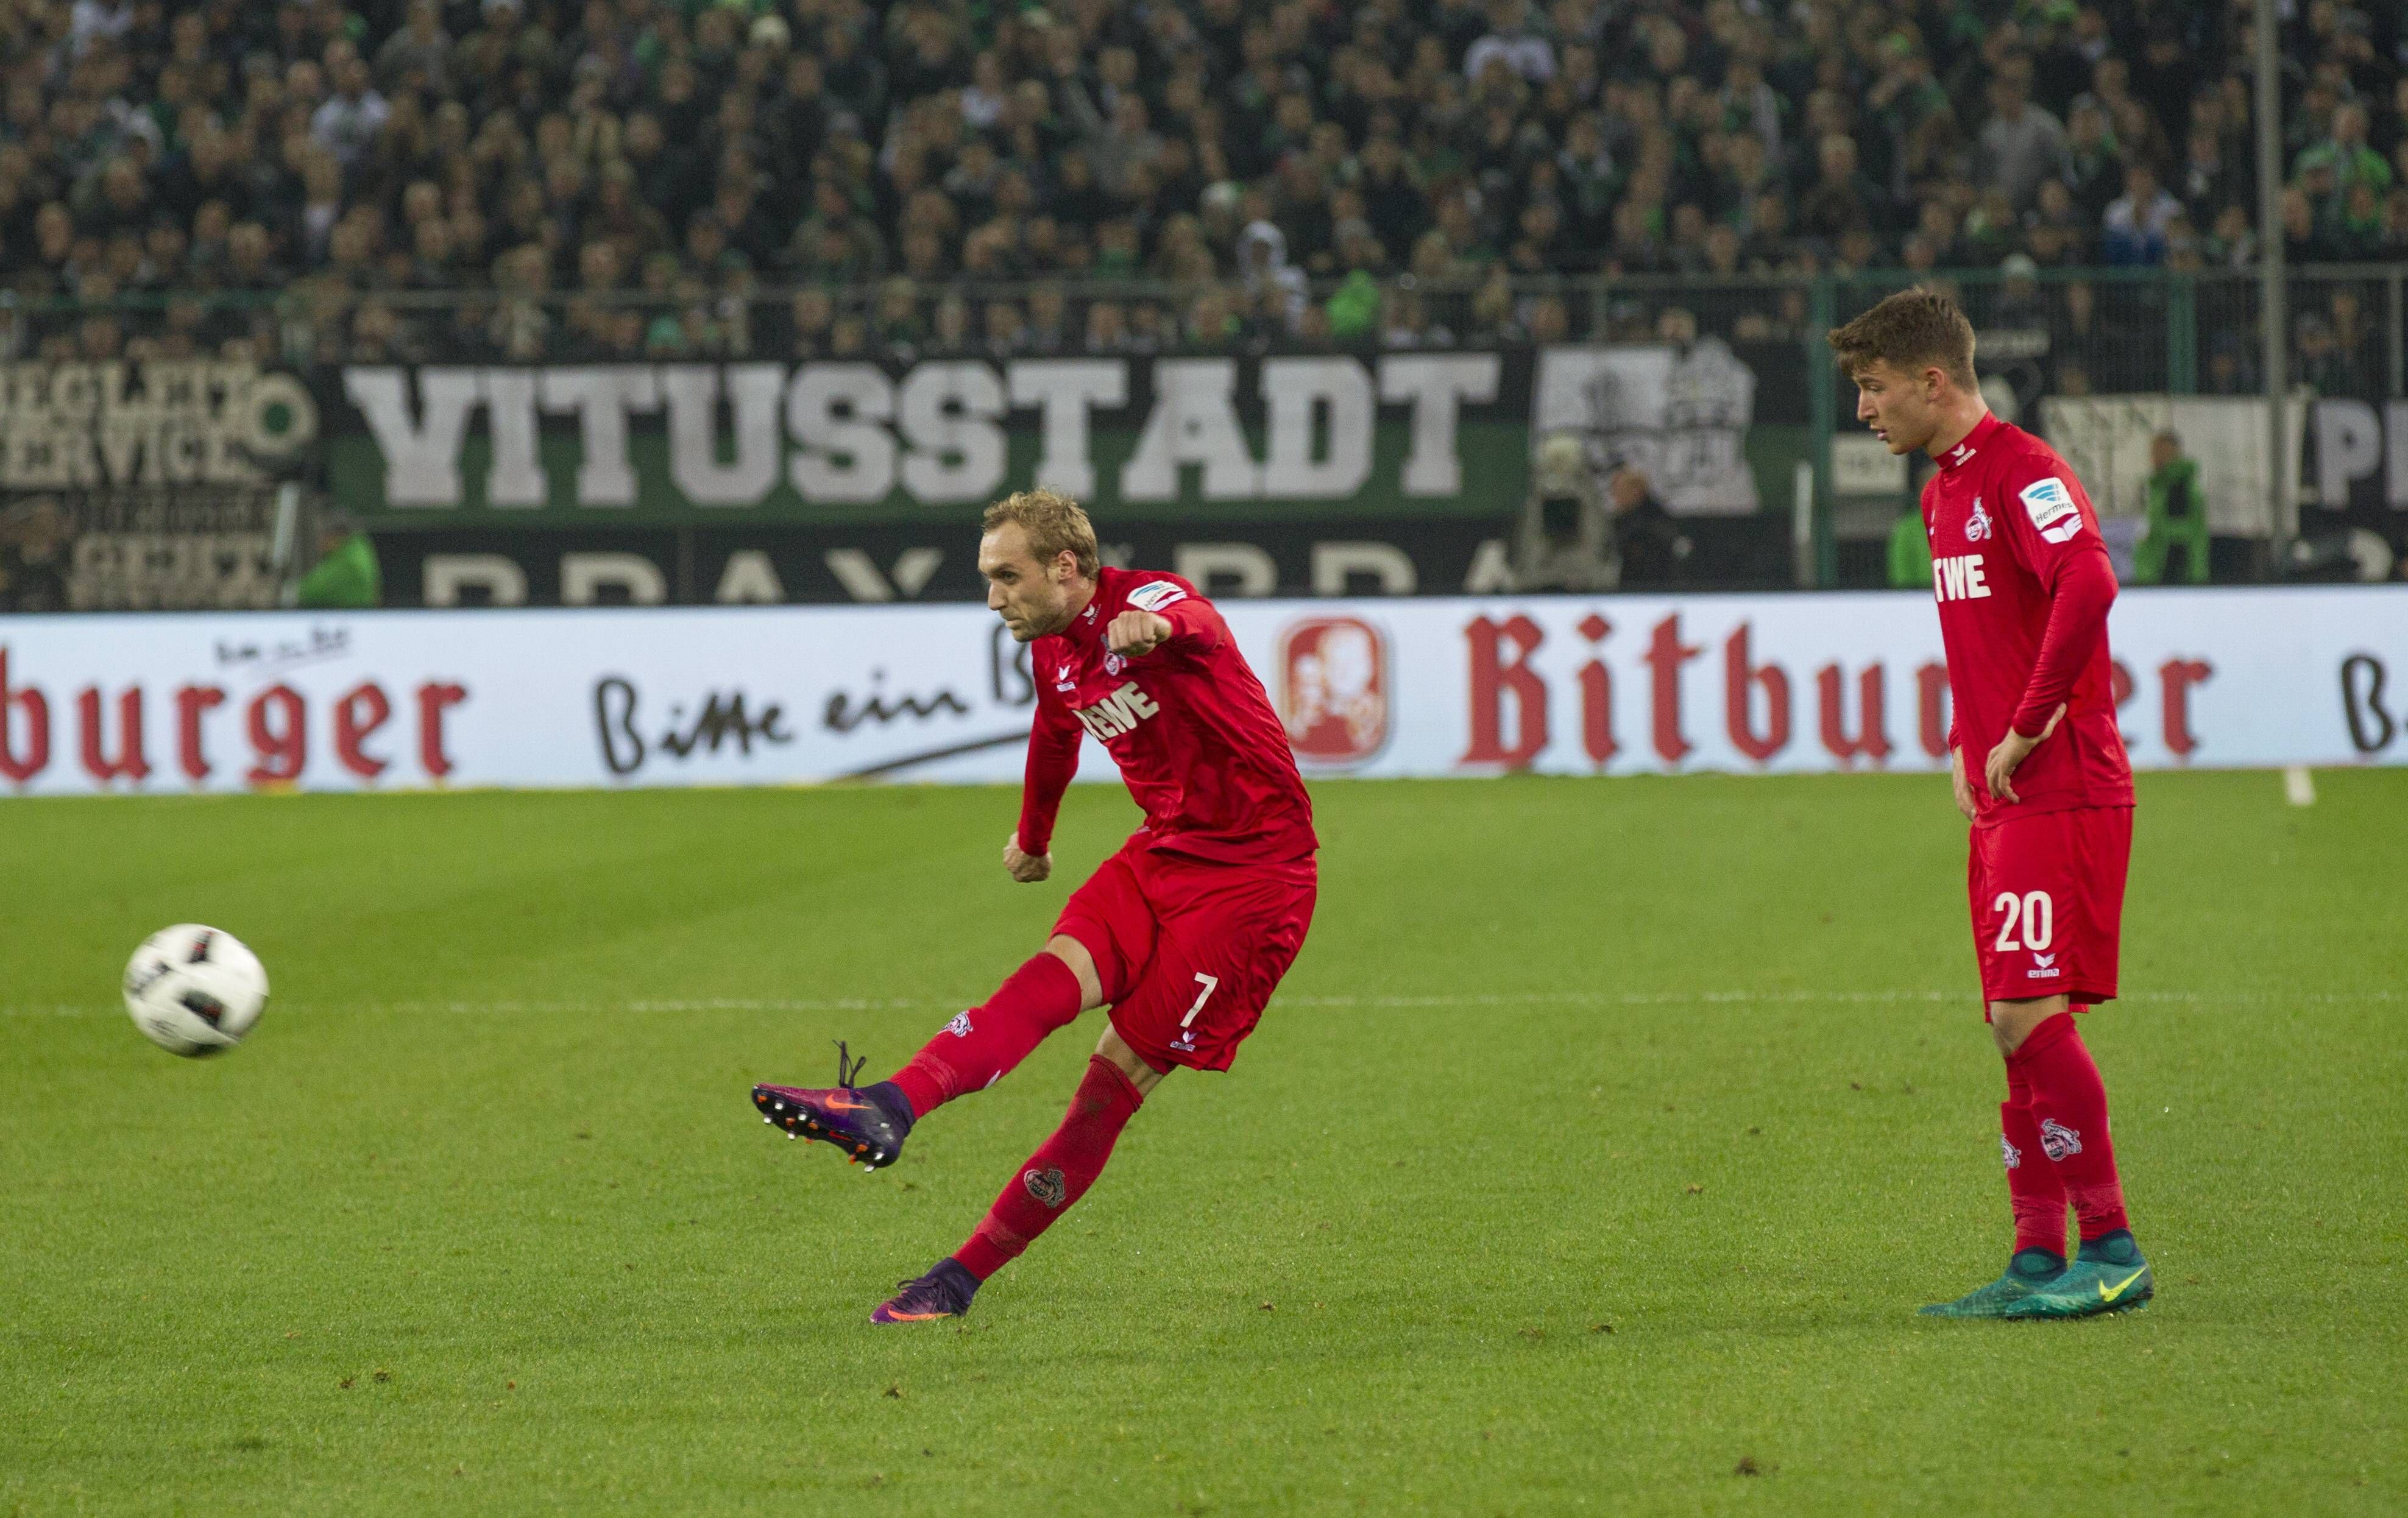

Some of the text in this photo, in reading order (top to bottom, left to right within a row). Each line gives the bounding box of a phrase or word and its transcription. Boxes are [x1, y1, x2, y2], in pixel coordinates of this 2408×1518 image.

[342, 355, 1500, 508] VITUSSTADT
[2036, 503, 2073, 523] Hermes
[591, 673, 795, 776] Bitte
[823, 662, 969, 732] ein
[1459, 612, 2214, 769] Bitburr
[1994, 890, 2053, 952] 20
[1179, 971, 1219, 1028] 7
